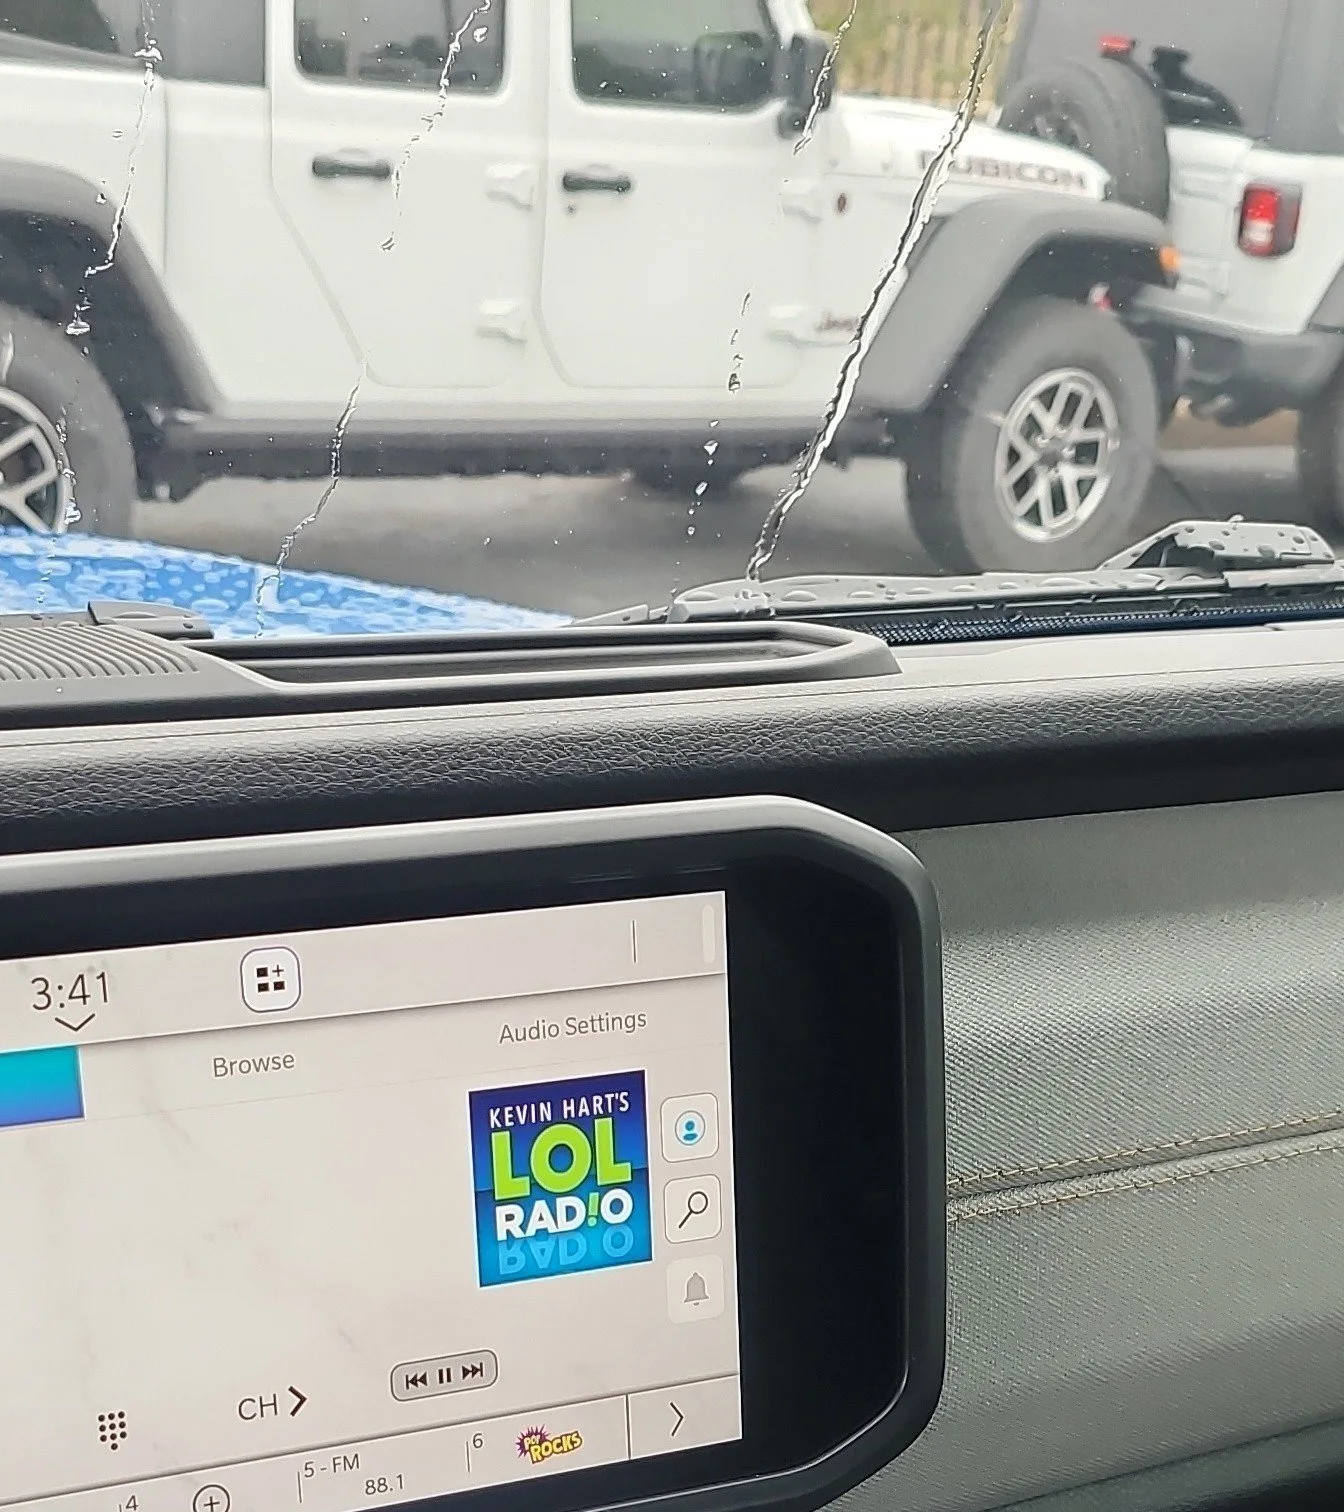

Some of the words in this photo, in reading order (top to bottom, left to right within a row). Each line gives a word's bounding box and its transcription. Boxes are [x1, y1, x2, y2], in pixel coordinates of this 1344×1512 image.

[31, 971, 110, 1011] 3:41
[499, 1018, 560, 1045] Audio
[565, 1009, 648, 1039] Settings
[212, 1050, 296, 1079] Browse
[489, 1101, 552, 1129] KEVIN
[562, 1091, 630, 1120] HART'S
[491, 1117, 632, 1200] LOL
[237, 1394, 279, 1421] CH
[472, 1432, 484, 1449] 6
[529, 1431, 584, 1464] ROCKS
[332, 1453, 361, 1474] FM
[364, 1474, 405, 1495] 88.1
[126, 1495, 139, 1511] 4
